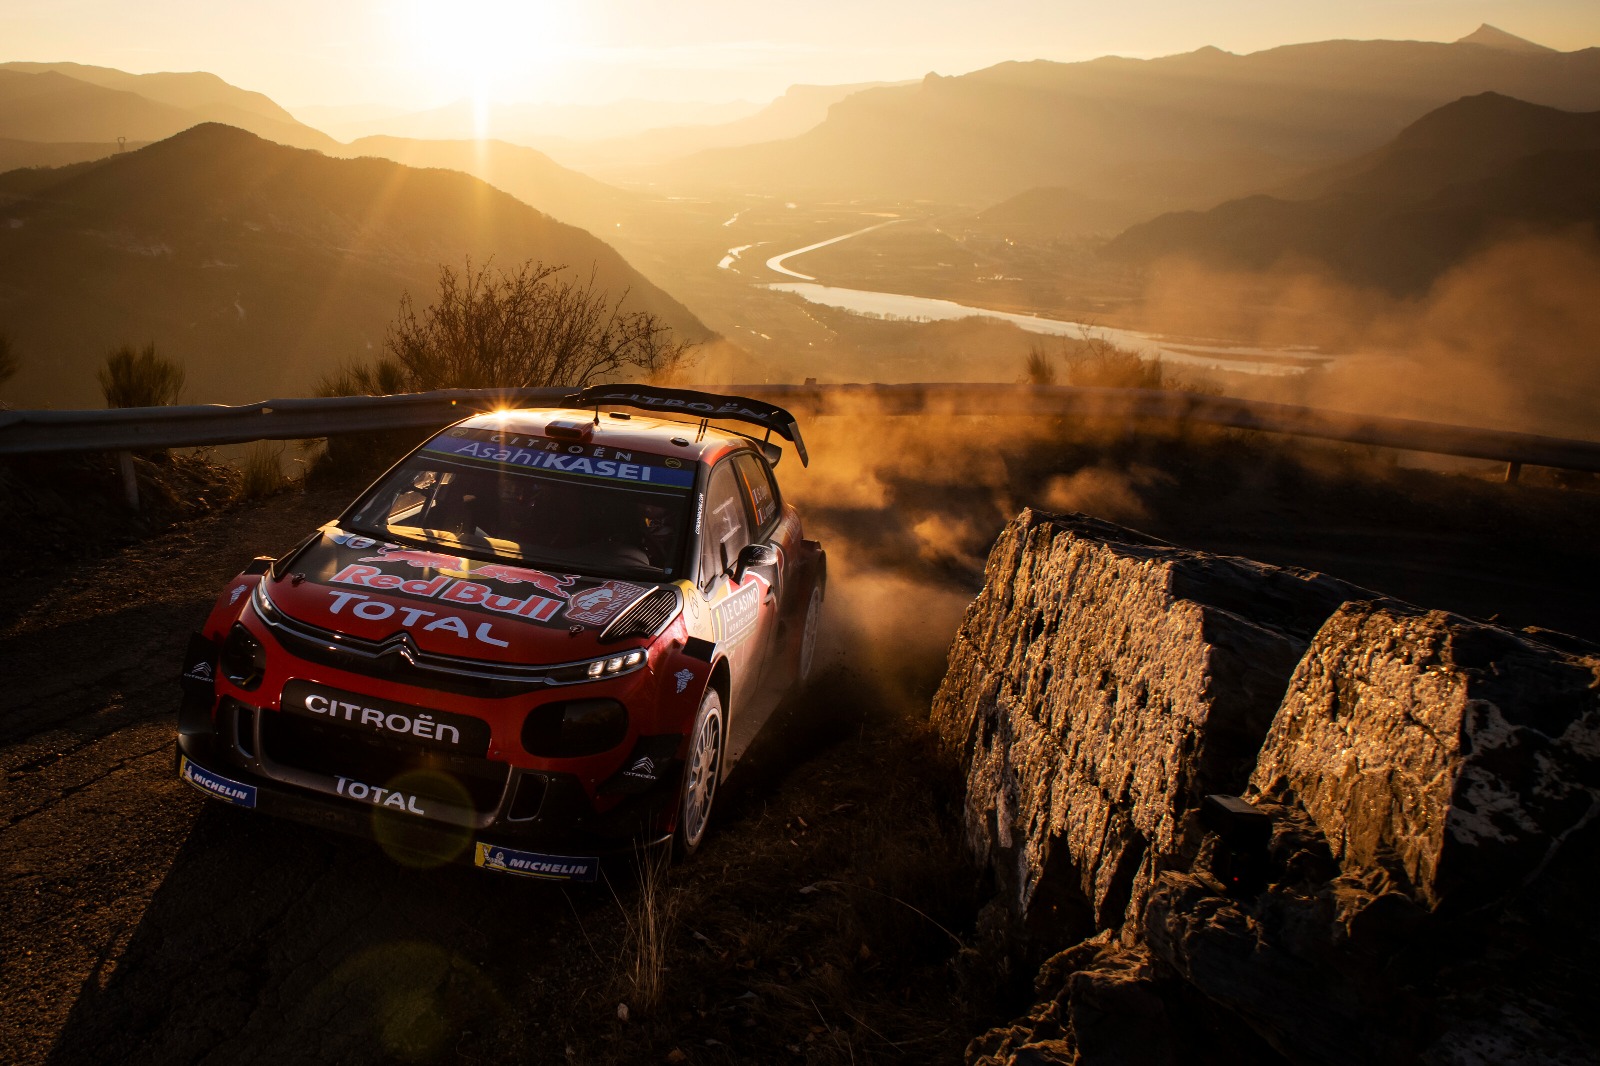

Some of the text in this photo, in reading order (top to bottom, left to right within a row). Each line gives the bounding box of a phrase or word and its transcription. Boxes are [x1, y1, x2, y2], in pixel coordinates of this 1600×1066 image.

[490, 434, 632, 461] CITROËN
[329, 564, 452, 598] Red
[440, 578, 565, 622] Bull
[724, 587, 758, 622] LE CASINO
[328, 590, 510, 648] TOTAL
[193, 772, 248, 800] MICHELIN
[334, 775, 425, 815] TOTAL
[508, 857, 589, 875] MICHELIN
